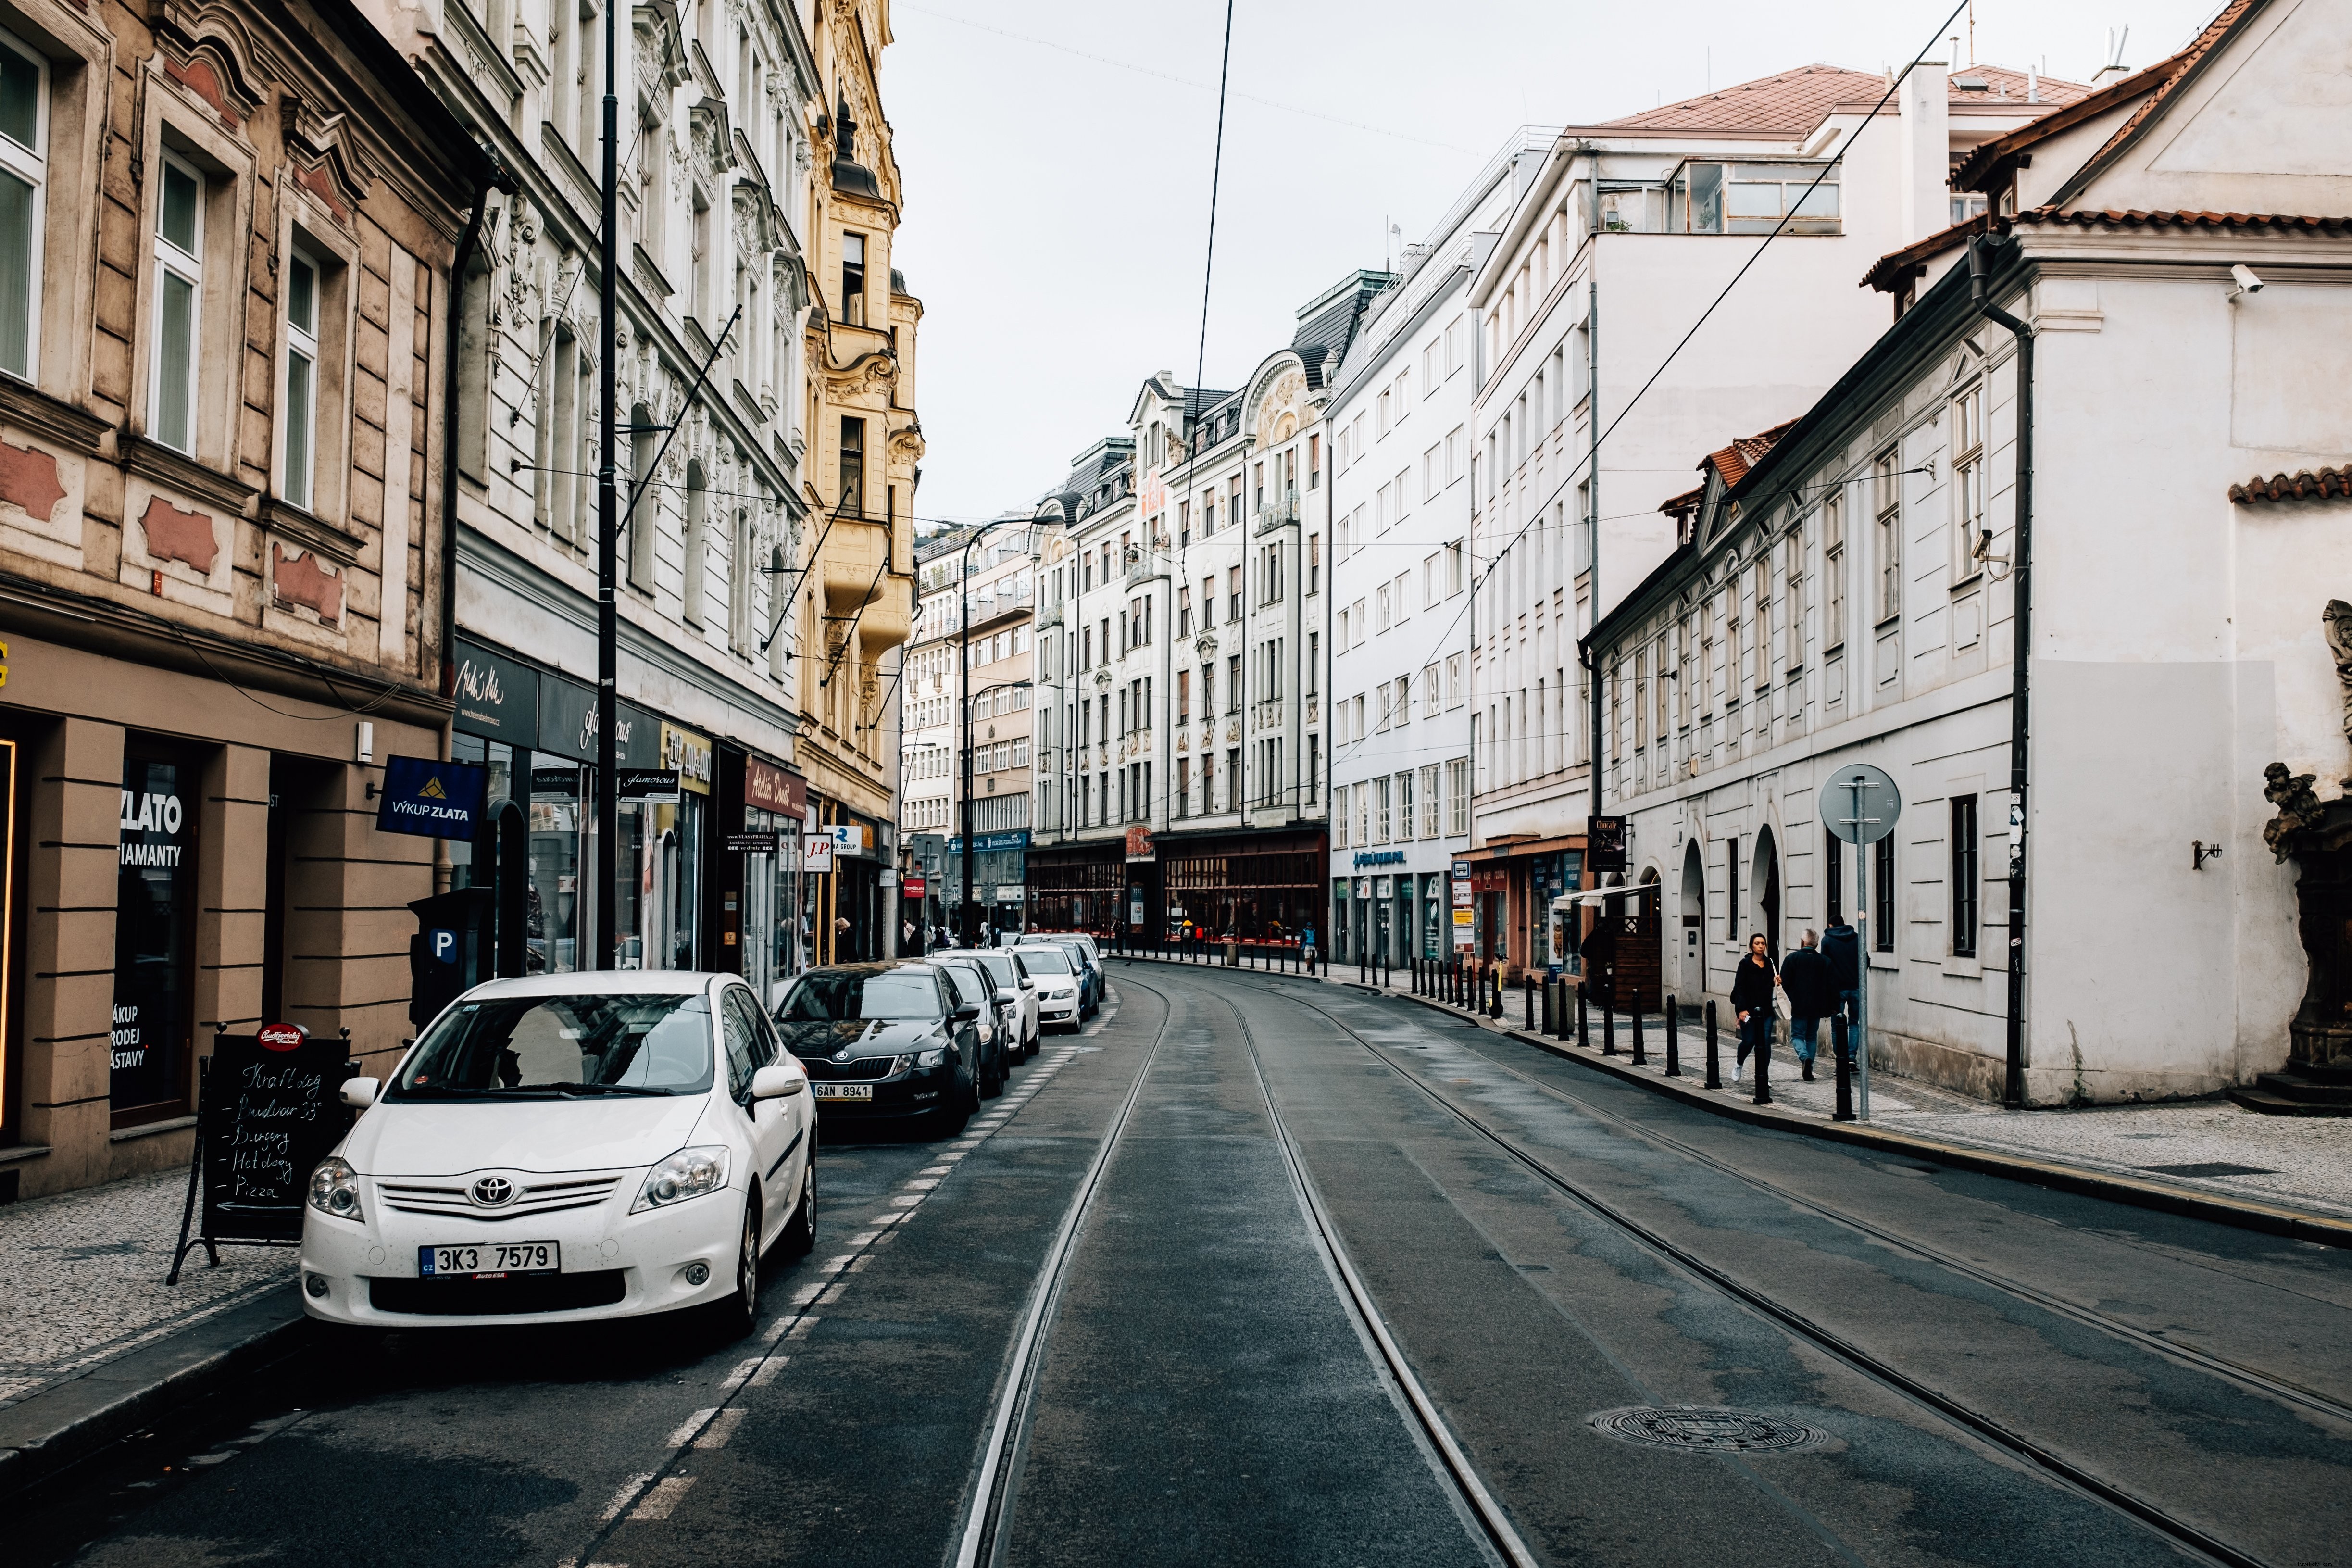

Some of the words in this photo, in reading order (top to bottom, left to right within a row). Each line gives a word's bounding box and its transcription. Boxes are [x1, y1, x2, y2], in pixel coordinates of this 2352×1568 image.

[580, 701, 630, 750] glaous
[623, 773, 675, 787] glamorous
[393, 800, 430, 815] VÝKUP
[431, 806, 468, 821] ZLATA
[120, 843, 181, 866] IAMANTY
[807, 842, 829, 858] J.P.
[437, 932, 453, 957] P
[112, 1003, 138, 1023] ÁKUP
[110, 1028, 140, 1046] RODEJ
[110, 1049, 144, 1069] ÁSTAVY
[243, 1063, 297, 1088] Kraft
[817, 1086, 836, 1096] 6AN
[843, 1086, 867, 1096] 8941
[233, 1149, 258, 1171] Hot
[236, 1174, 279, 1198] Pizza
[439, 1249, 478, 1271] 3K3
[496, 1245, 548, 1268] 7579
